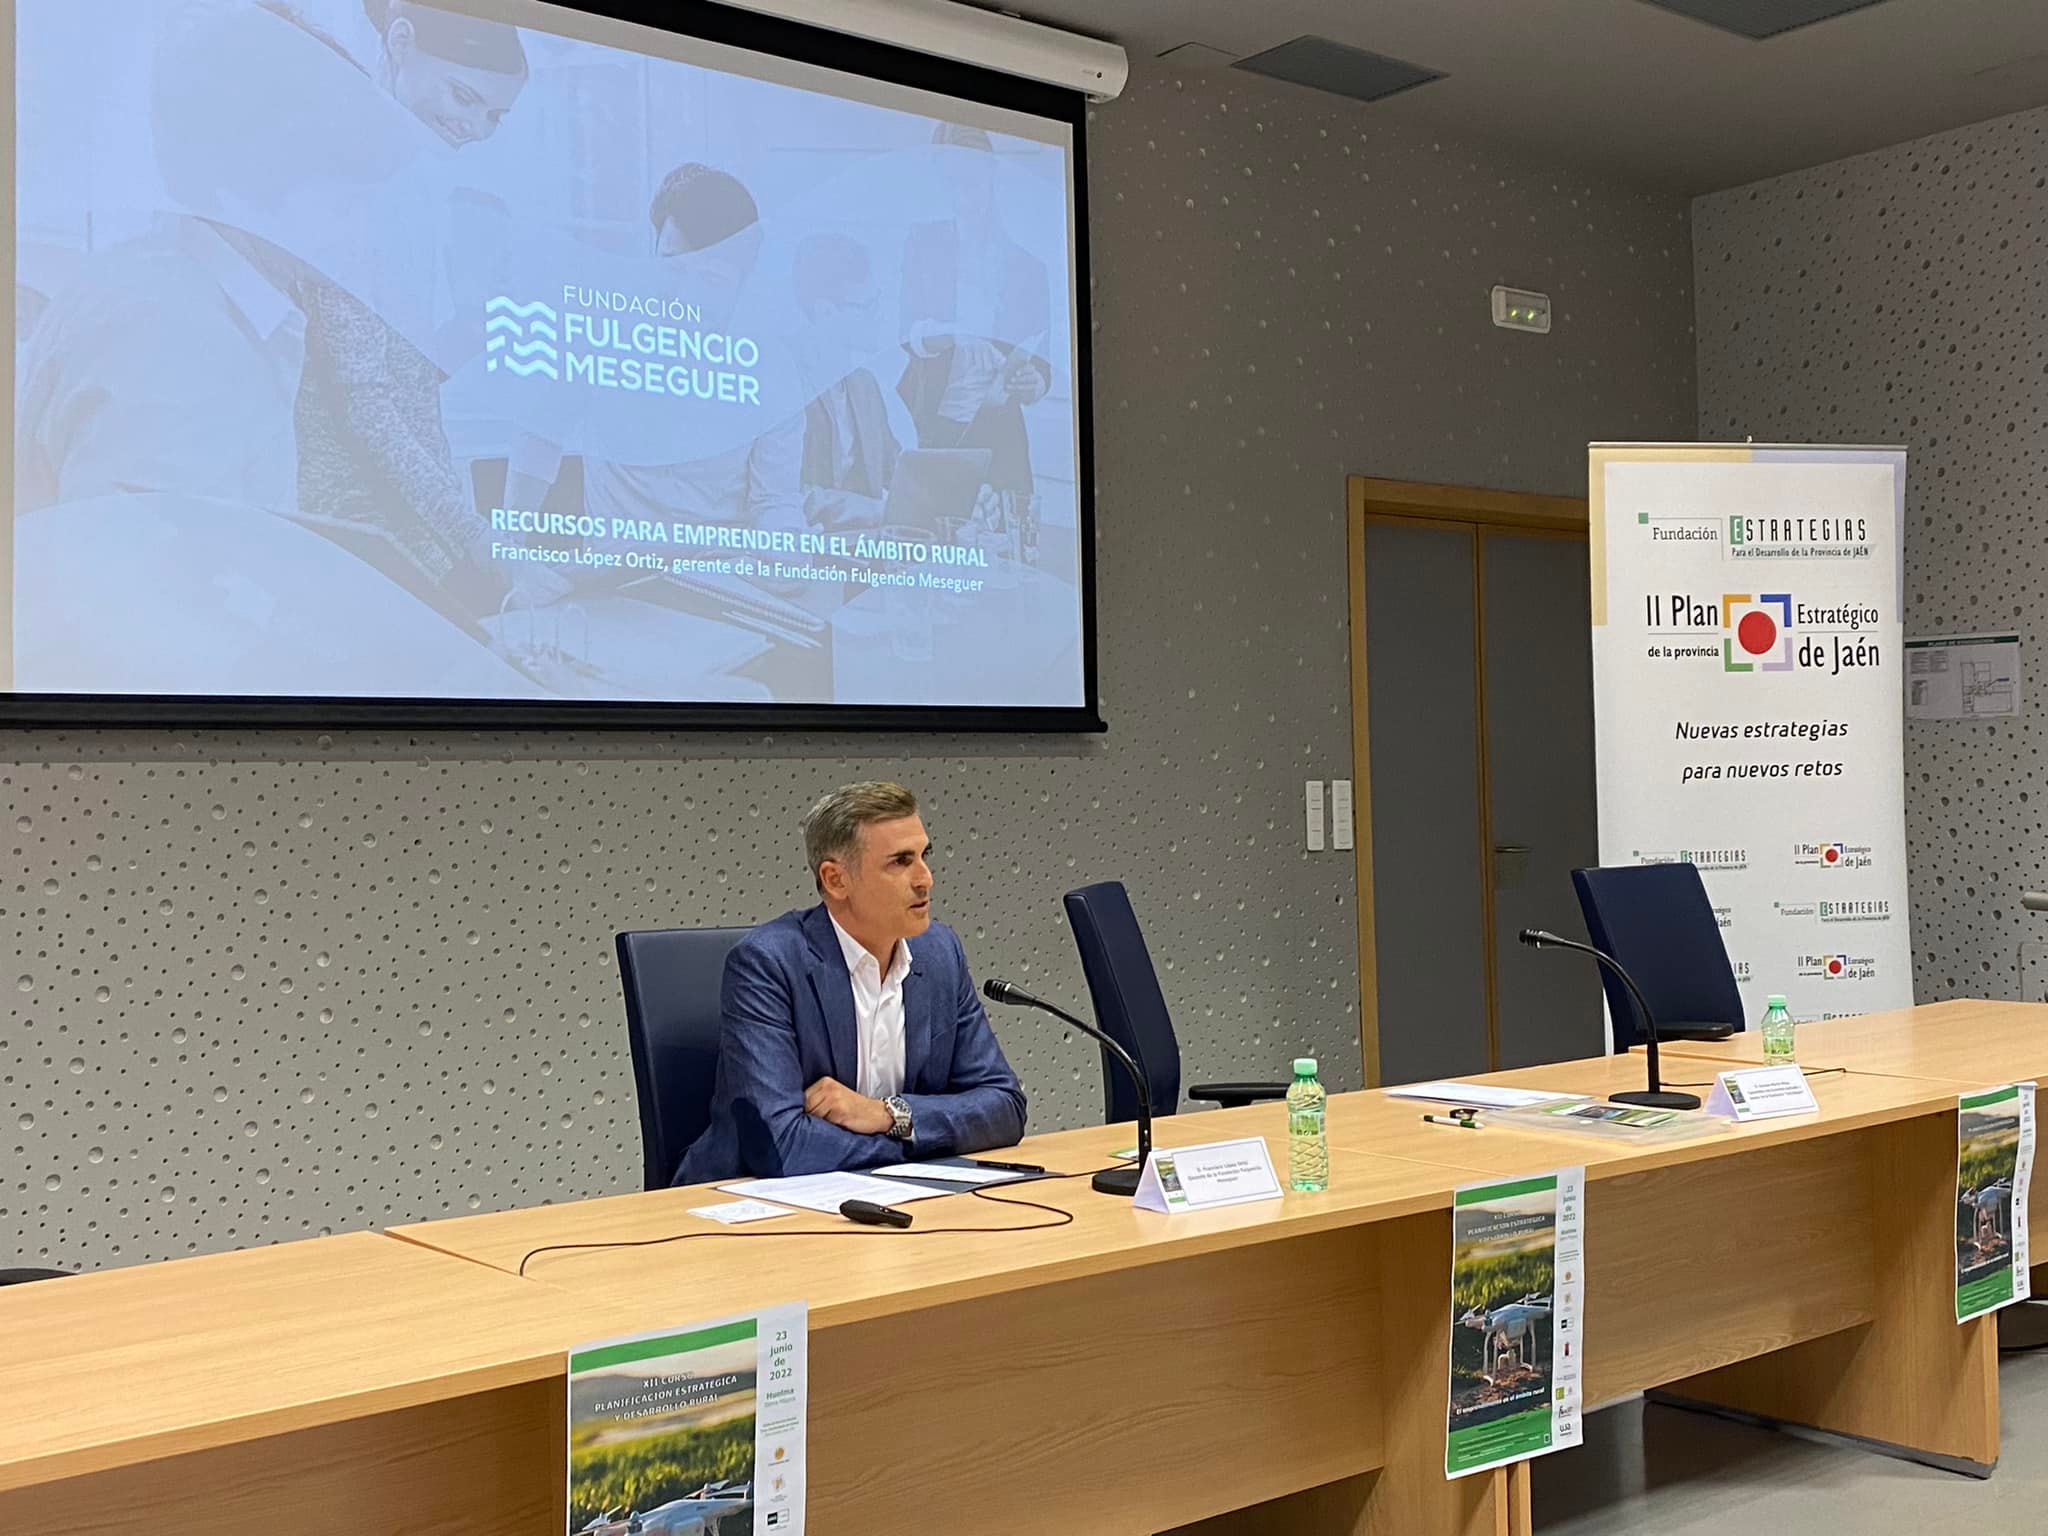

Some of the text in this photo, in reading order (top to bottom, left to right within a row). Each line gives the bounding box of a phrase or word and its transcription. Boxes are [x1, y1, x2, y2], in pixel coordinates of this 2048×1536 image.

[563, 284, 701, 323] FUNDACIÓN
[564, 313, 759, 367] FULGENCIO
[565, 351, 761, 405] MESEGUER
[491, 508, 989, 568] RECURSOS PARA EMPRENDER EN EL ÁMBITO RURAL
[1652, 526, 1718, 541] Fundación
[1732, 518, 1867, 542] ESTRATEGIAS
[1731, 546, 1747, 557] Para
[1748, 546, 1755, 557] el
[1755, 546, 1790, 557] Desarrollo
[1791, 546, 1800, 557] de
[1802, 546, 1809, 557] la
[1810, 546, 1842, 557] Provincia
[1843, 546, 1851, 557] de
[491, 541, 984, 593] Francisco López Ortiz, gerente de la Fundación Fulgencio Meseguer
[1646, 595, 1719, 627] II Plan
[1797, 603, 1879, 630] Estratégico
[1648, 645, 1720, 661] de la provincia
[1798, 636, 1825, 668] de
[1831, 636, 1880, 676] Jaén
[1675, 719, 1849, 742] Nuevas estrategias
[1681, 760, 1844, 784] para nuevos retos
[1802, 844, 1819, 855] Plan
[1845, 857, 1854, 867] de
[1717, 917, 1732, 928] aén
[1806, 955, 1823, 967] Plan
[1848, 968, 1857, 979] de
[775, 1330, 788, 1341] 23
[774, 1357, 786, 1367] de
[769, 1368, 793, 1381] 2022
[643, 1377, 659, 1389] XII
